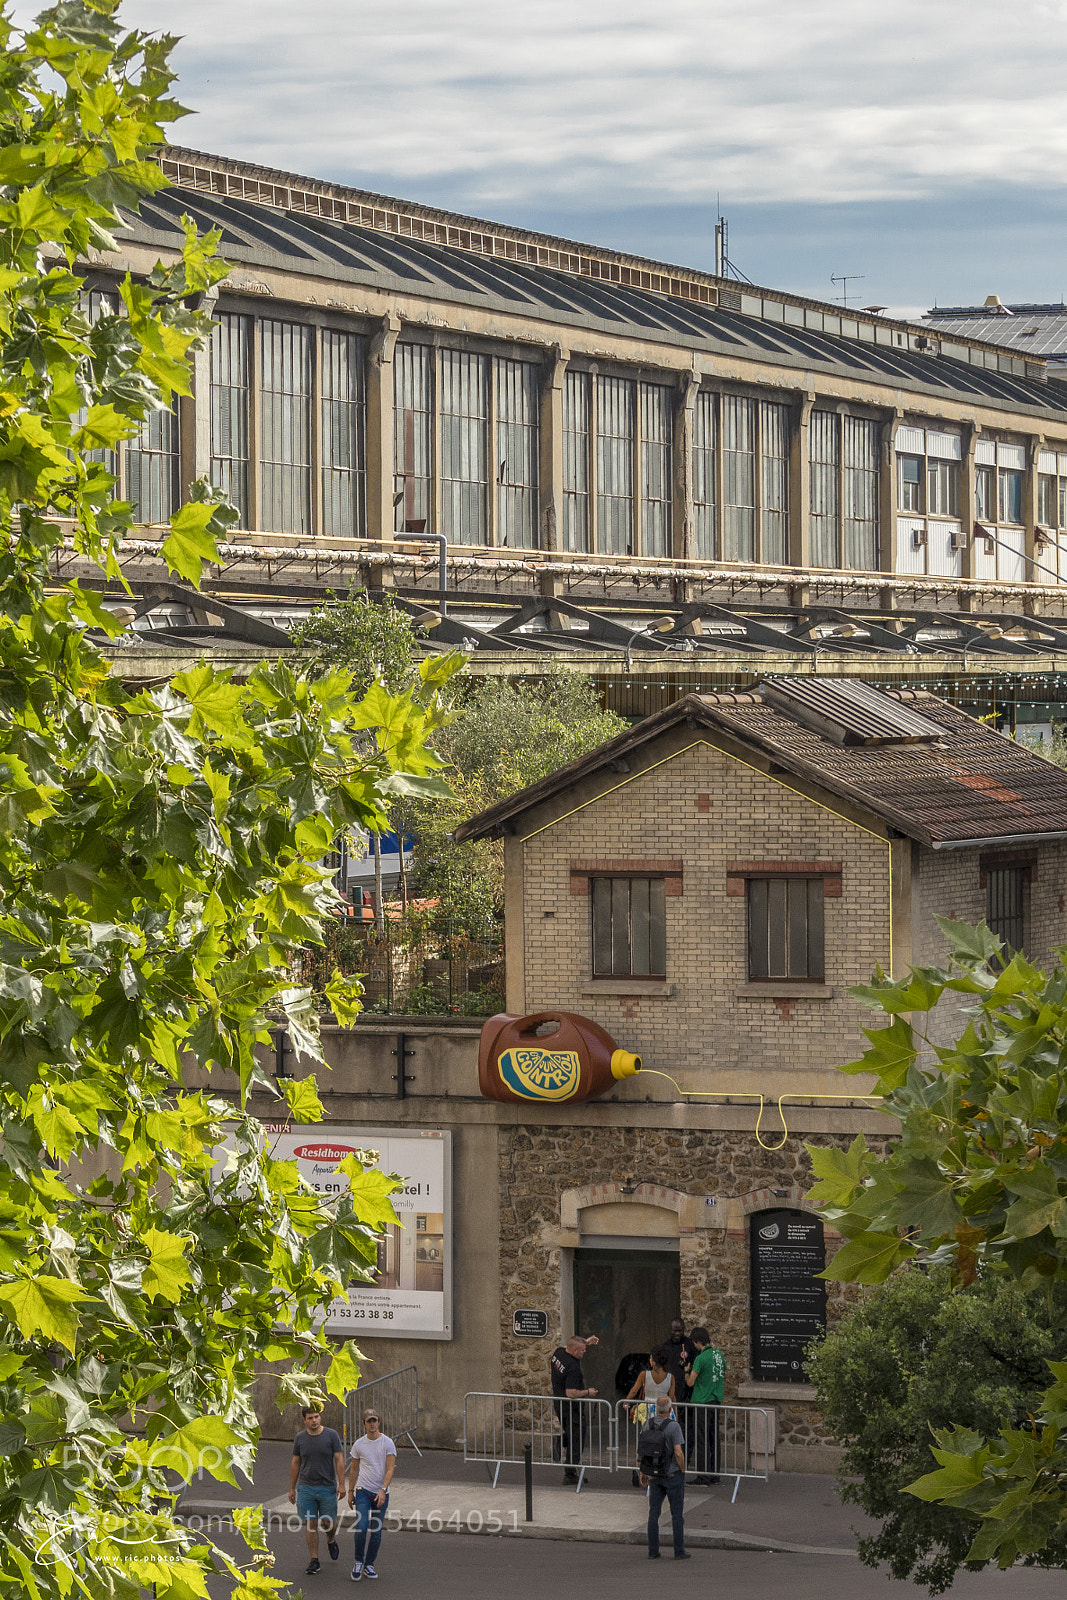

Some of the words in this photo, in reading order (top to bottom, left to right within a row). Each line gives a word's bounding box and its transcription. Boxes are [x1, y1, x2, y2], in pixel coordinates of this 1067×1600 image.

[263, 1124, 290, 1133] ENIR
[325, 1183, 341, 1192] en
[391, 1200, 415, 1210] omilly
[325, 1308, 337, 1317] 01
[340, 1308, 352, 1318] 53
[354, 1309, 366, 1319] 23
[368, 1310, 380, 1319] 38
[382, 1311, 394, 1320] 38
